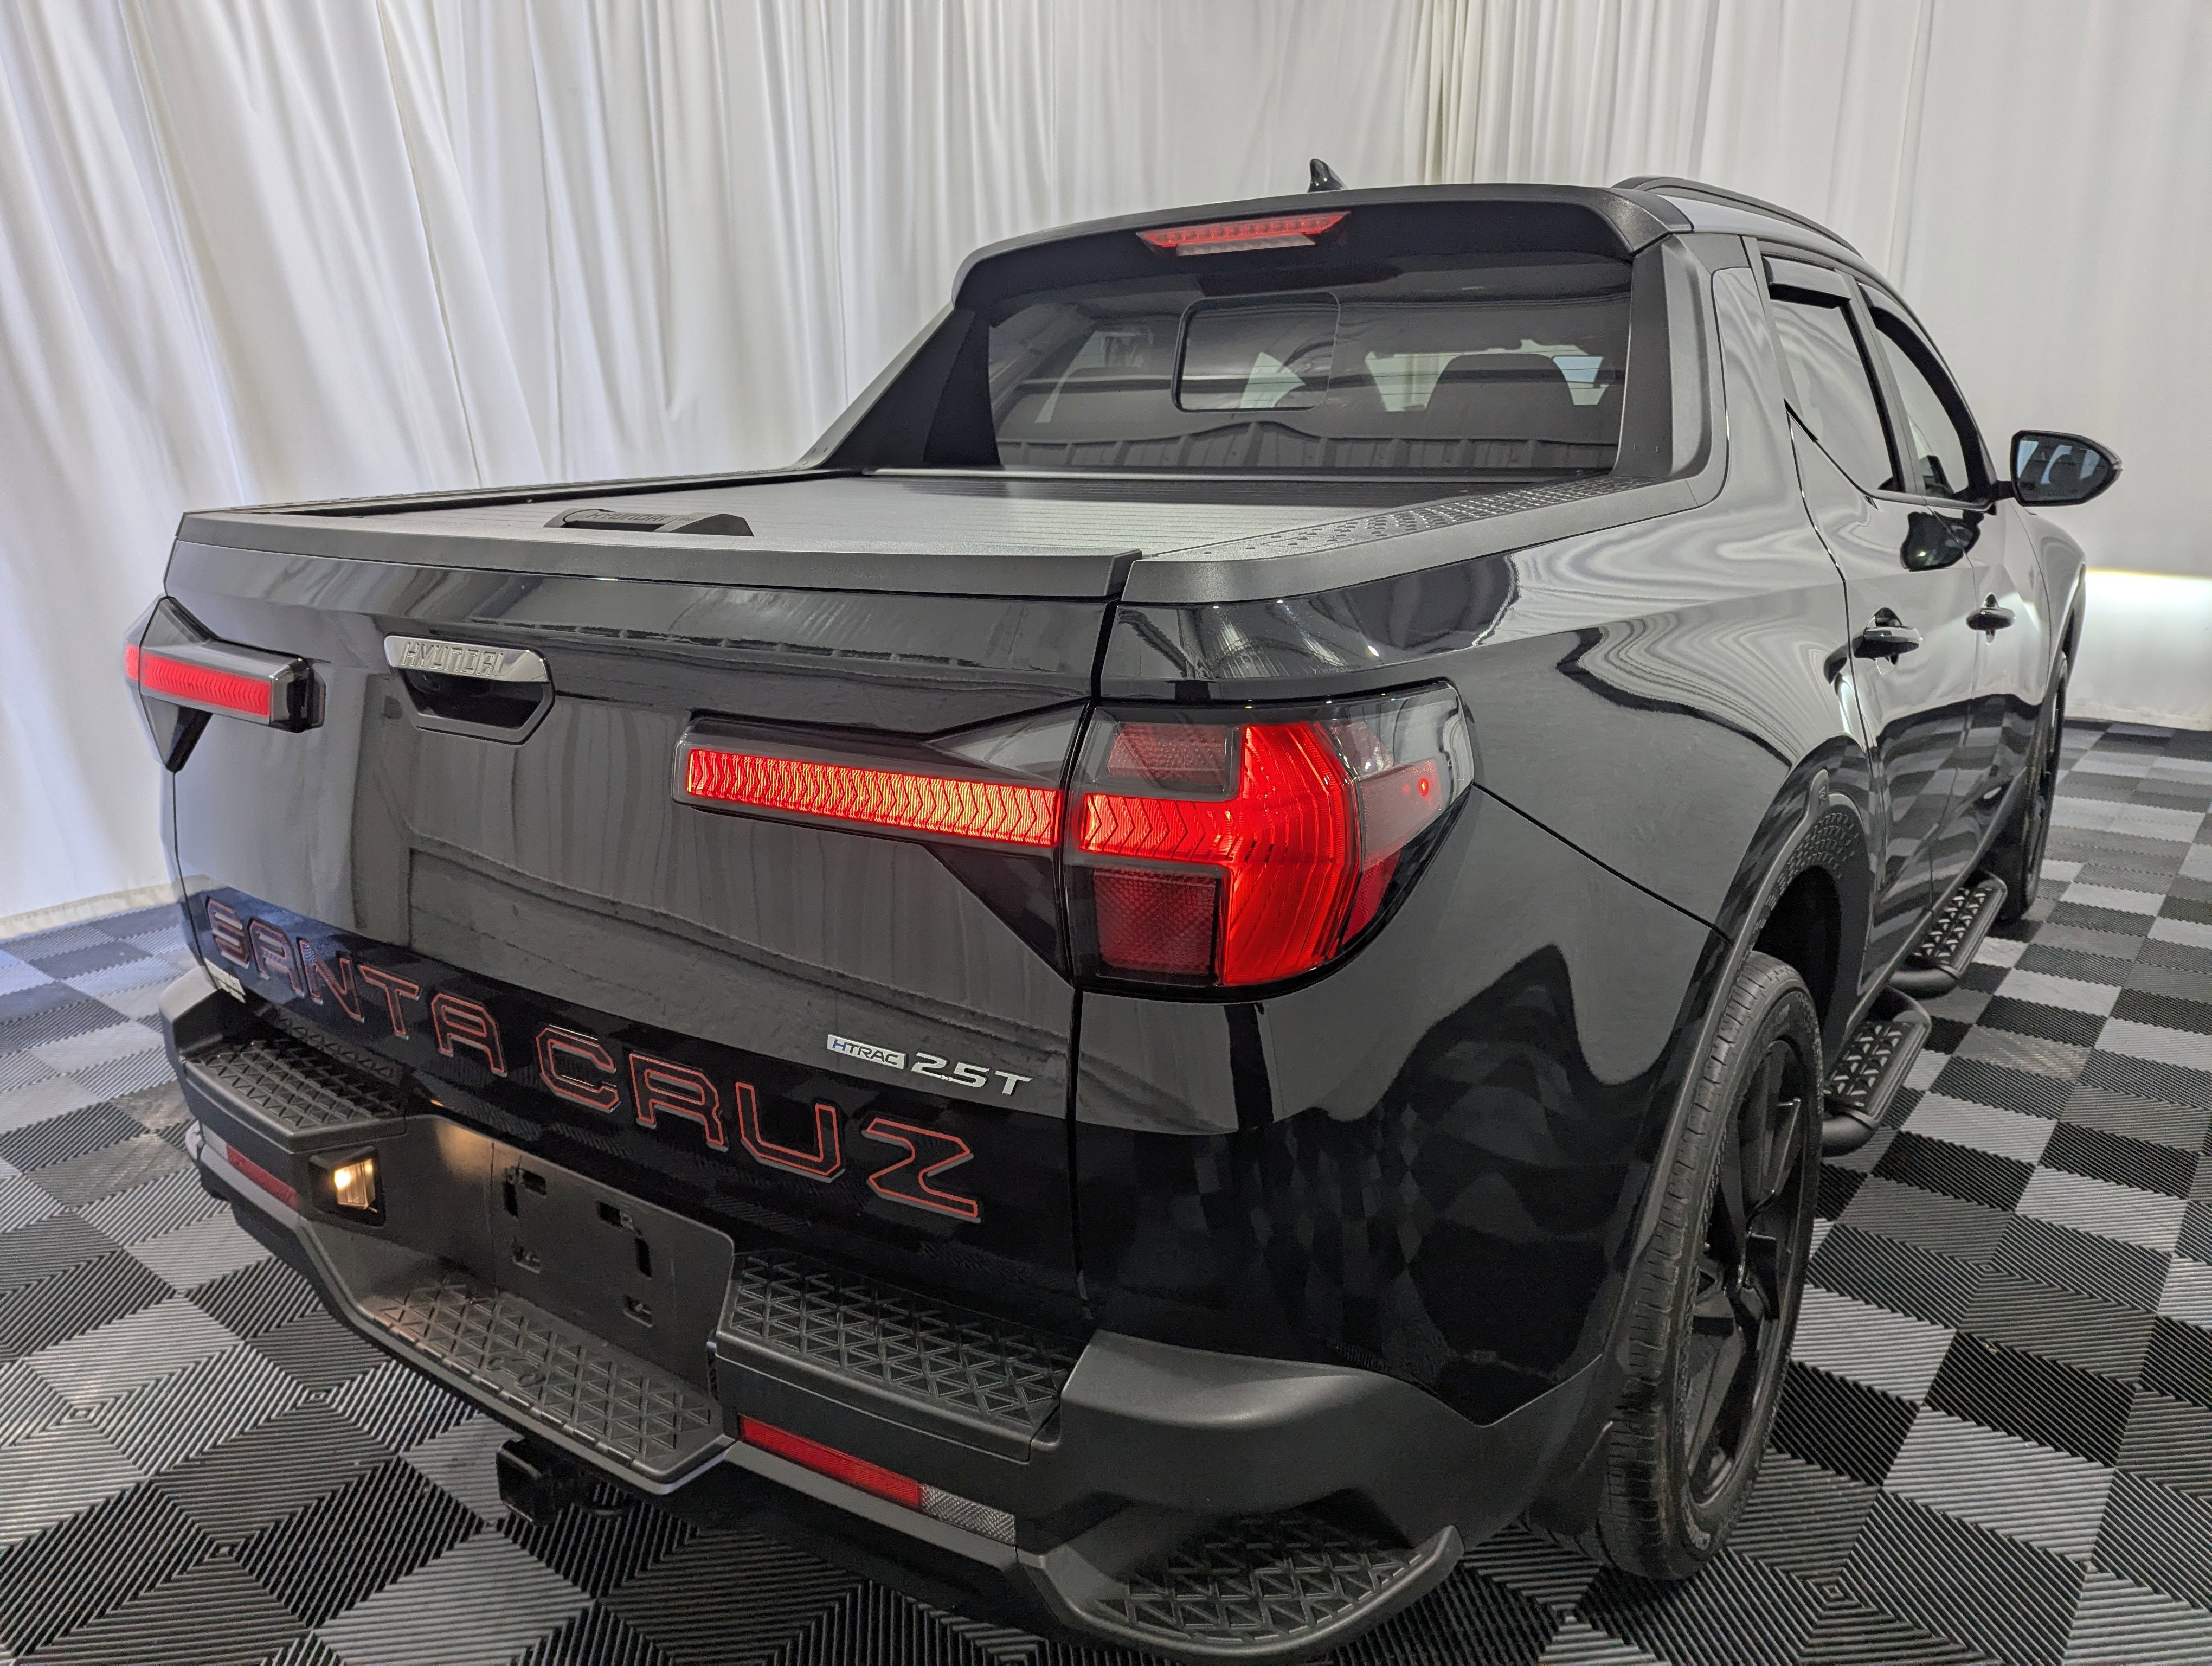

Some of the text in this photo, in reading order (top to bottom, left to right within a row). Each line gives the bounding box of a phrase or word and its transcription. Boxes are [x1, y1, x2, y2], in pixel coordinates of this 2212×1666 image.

[586, 512, 671, 522] HYUNDAI
[400, 642, 504, 677] HYUNDAI
[205, 895, 981, 1223] SANTA CRUZ
[832, 1039, 899, 1066] HTRAC
